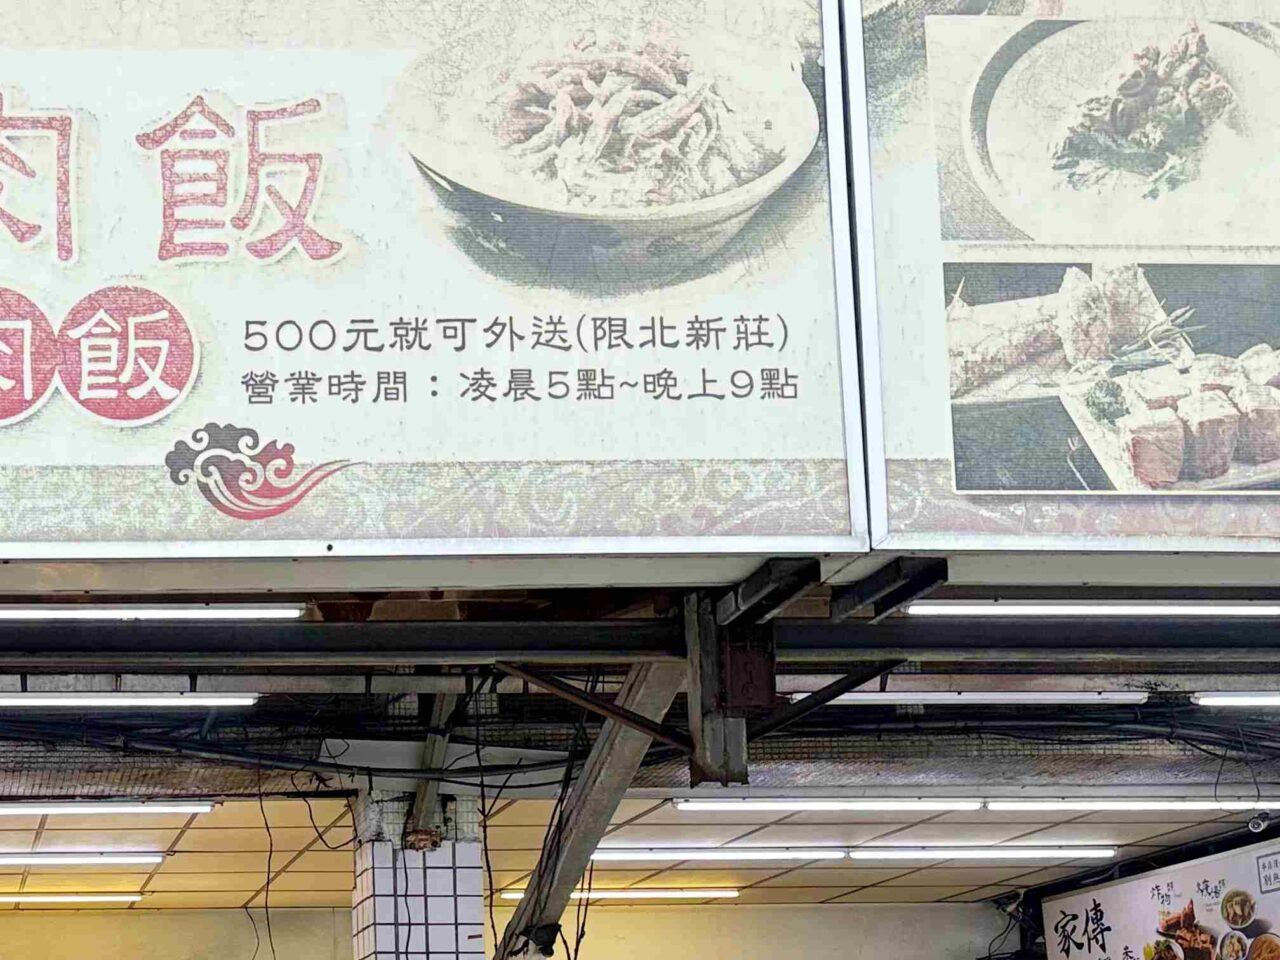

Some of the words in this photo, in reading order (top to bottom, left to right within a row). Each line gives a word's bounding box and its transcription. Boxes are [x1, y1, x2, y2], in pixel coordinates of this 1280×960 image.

[242, 315, 789, 352] 500元就可外送(限北新莊)
[1054, 898, 1112, 959] 家傳
